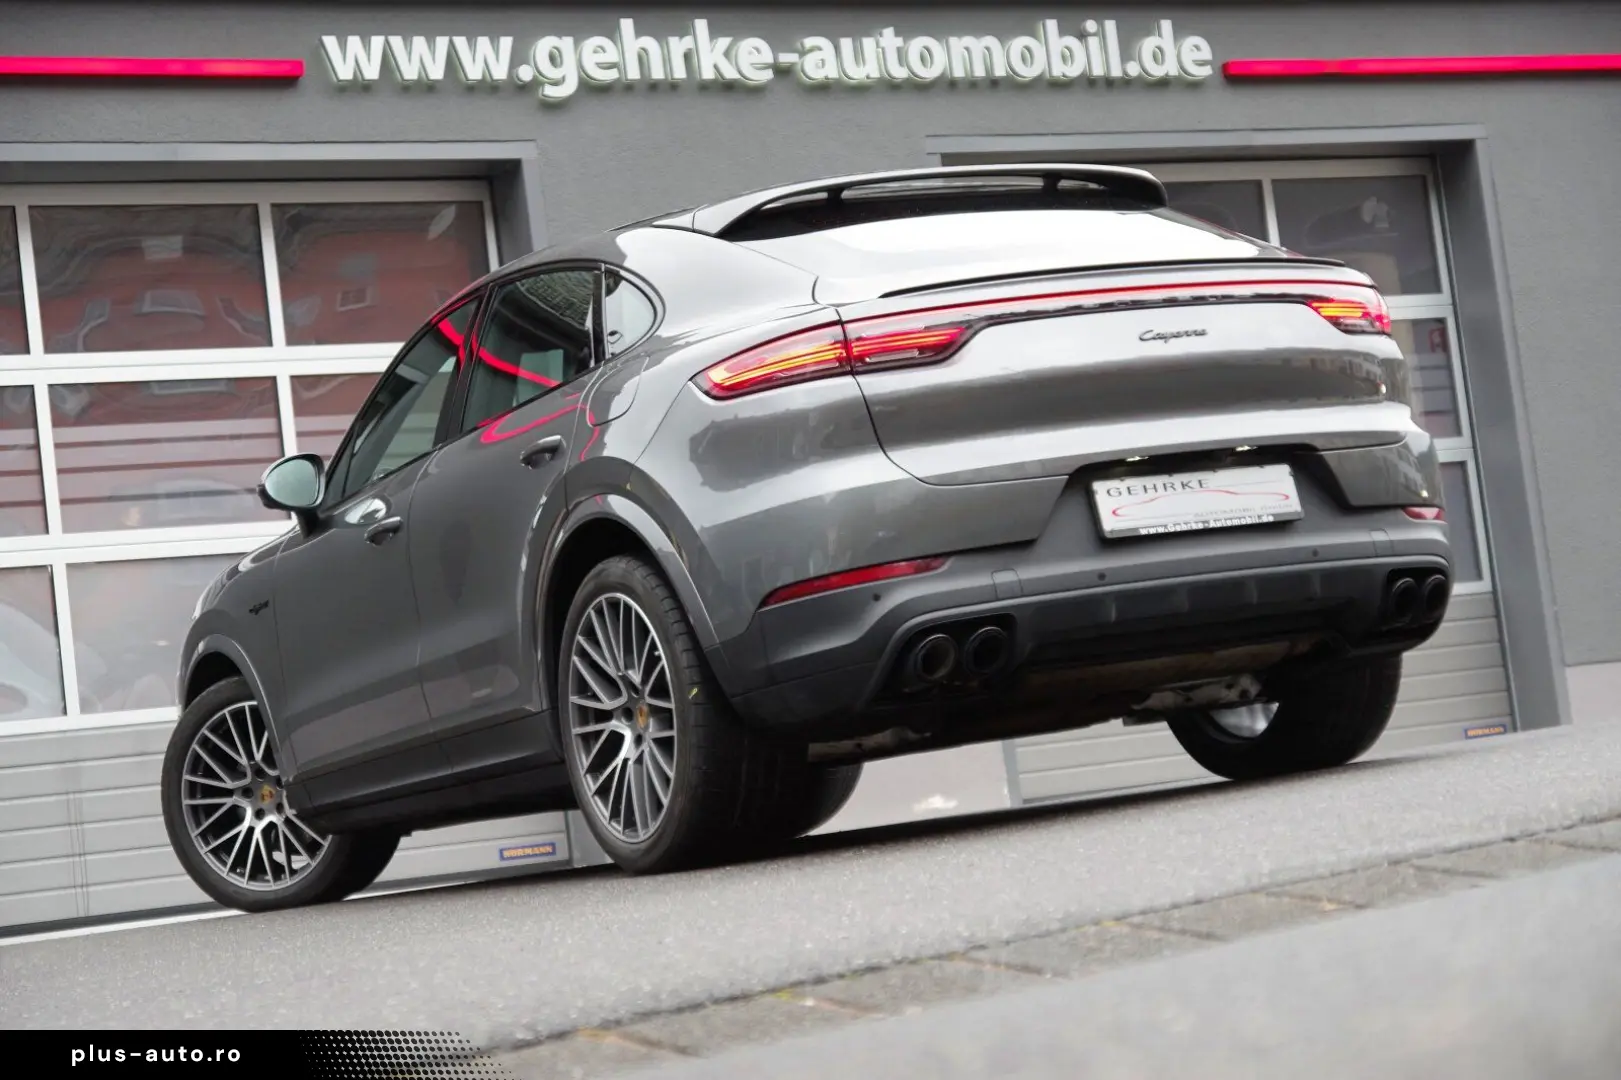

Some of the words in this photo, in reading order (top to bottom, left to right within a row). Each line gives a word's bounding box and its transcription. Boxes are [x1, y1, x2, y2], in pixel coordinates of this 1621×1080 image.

[319, 17, 1214, 100] www.gehrke-automobil.de
[1138, 329, 1209, 344] Cayenne
[1106, 479, 1211, 498] GEHRKE
